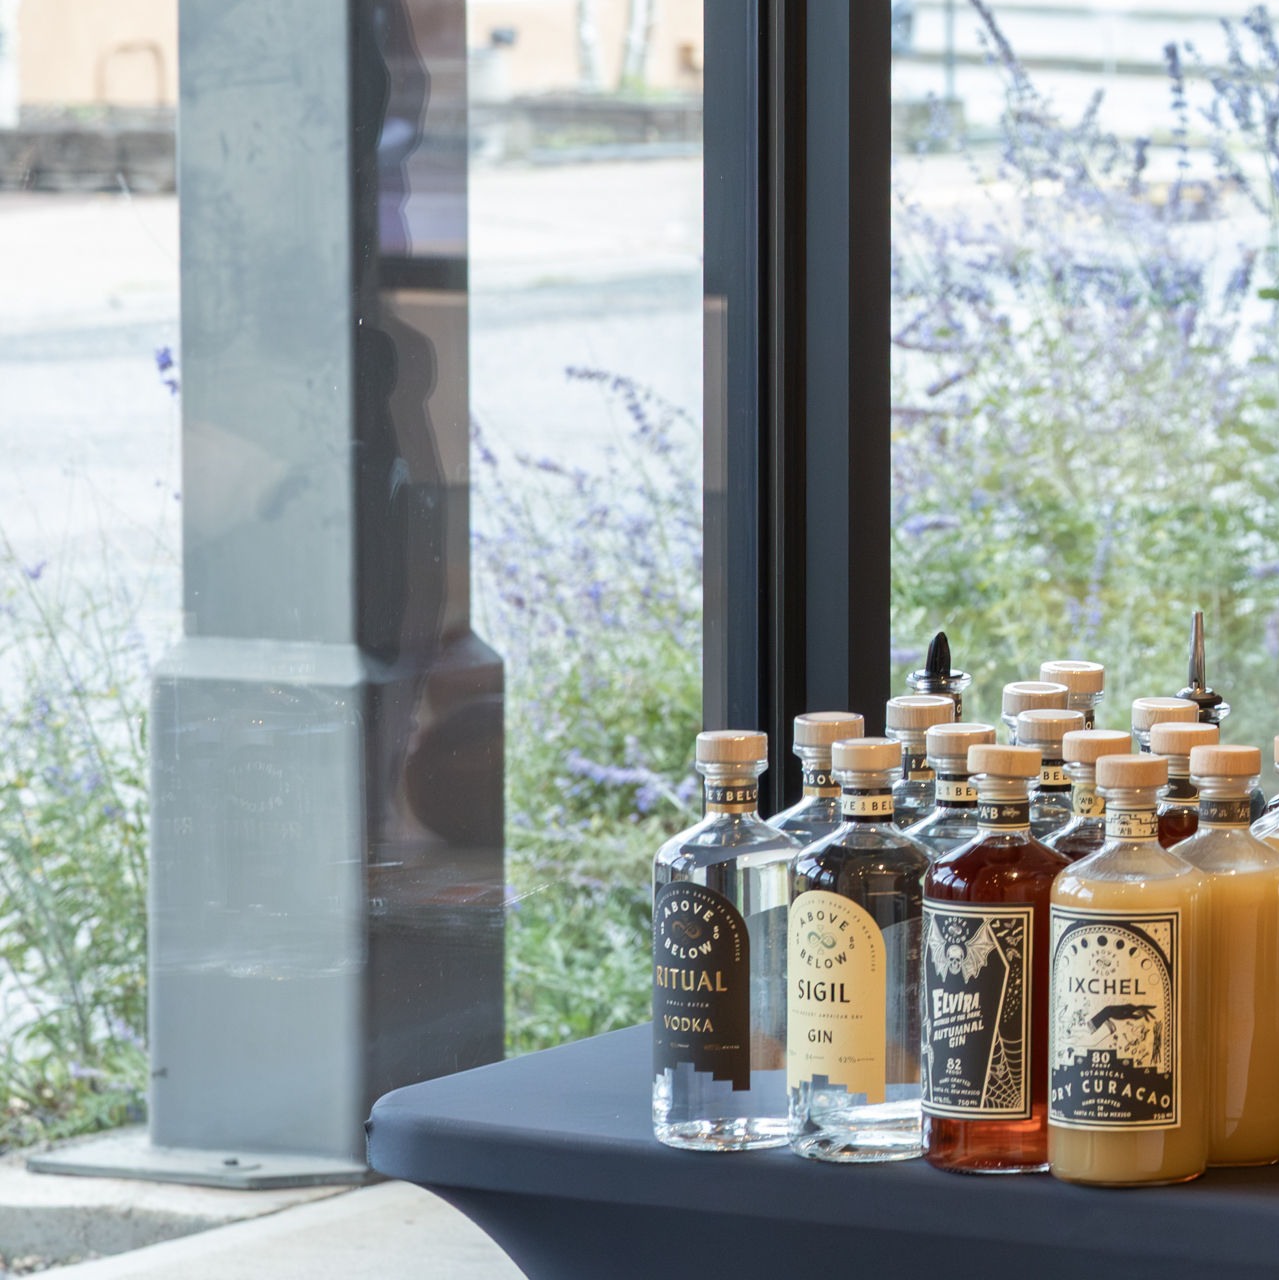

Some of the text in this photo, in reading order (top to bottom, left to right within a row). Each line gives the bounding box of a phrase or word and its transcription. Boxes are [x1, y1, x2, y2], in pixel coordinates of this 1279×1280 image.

[663, 900, 714, 922] ABOVE
[800, 910, 850, 933] ABOVE
[664, 937, 713, 960] BELOW
[800, 948, 848, 970] BELOW
[656, 965, 729, 992] RITUAL
[1068, 977, 1147, 995] IXCHEL
[797, 979, 851, 1004] SIGIL
[932, 988, 980, 1020] ELVIRA
[663, 1013, 715, 1033] VODKA
[933, 1020, 984, 1042] AUTUMNAL
[807, 1028, 833, 1044] GIN
[949, 1035, 967, 1048] GIN
[947, 1057, 962, 1070] 82
[1091, 1051, 1110, 1064] 80
[1080, 1070, 1125, 1080] BOTANICAL
[1052, 1080, 1171, 1108] DRY CURACAO
